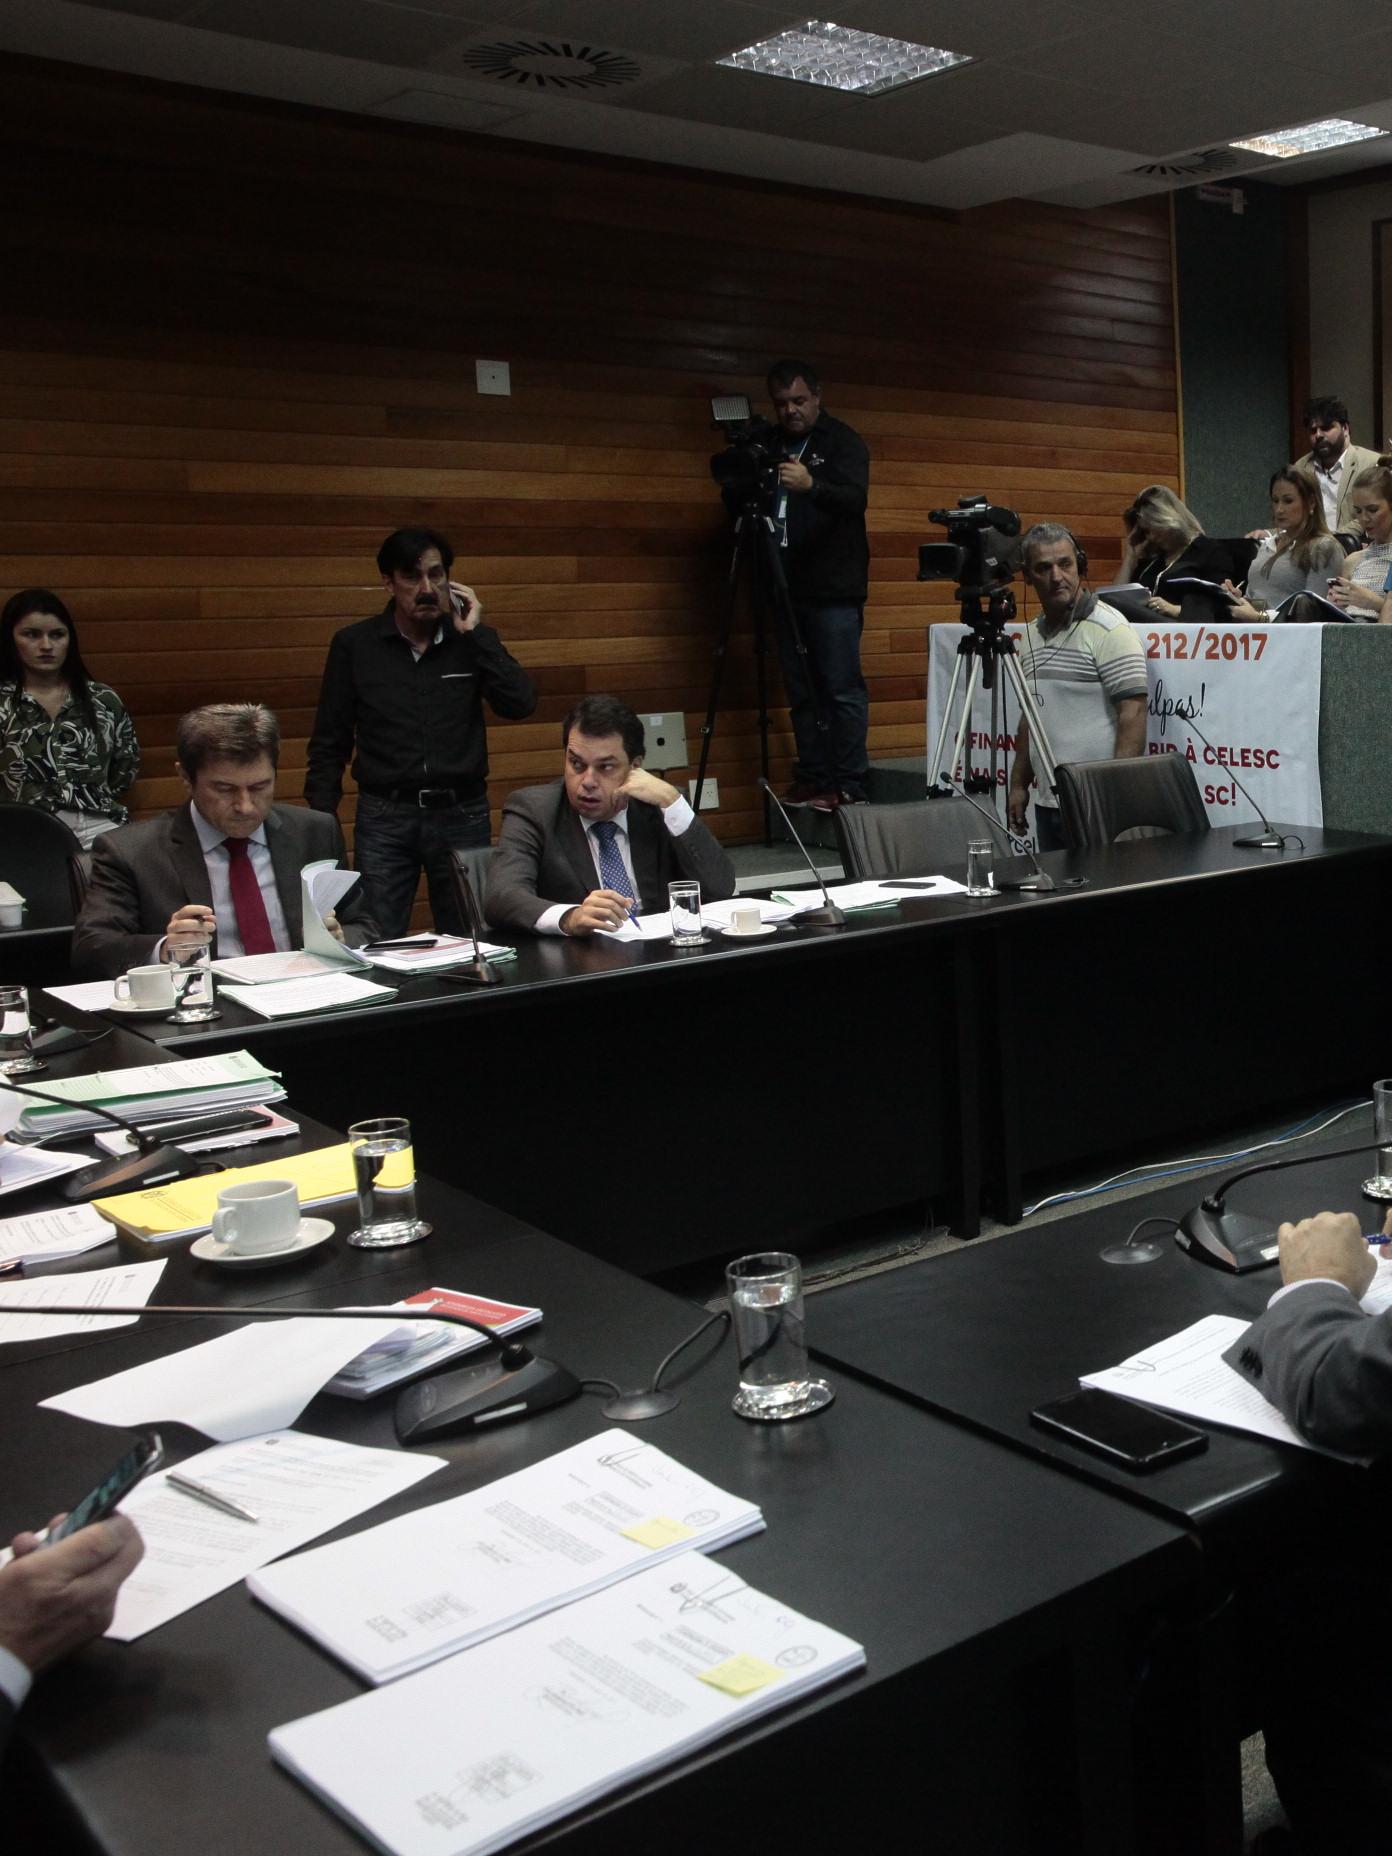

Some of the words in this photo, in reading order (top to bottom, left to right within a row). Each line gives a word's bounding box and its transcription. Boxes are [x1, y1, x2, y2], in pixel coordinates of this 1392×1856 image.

[1146, 626, 1268, 661] 212/2017
[970, 732, 1020, 752] FINAN
[1185, 737, 1198, 764] À
[1203, 744, 1281, 770] CELESC
[1204, 782, 1237, 807] SC!
